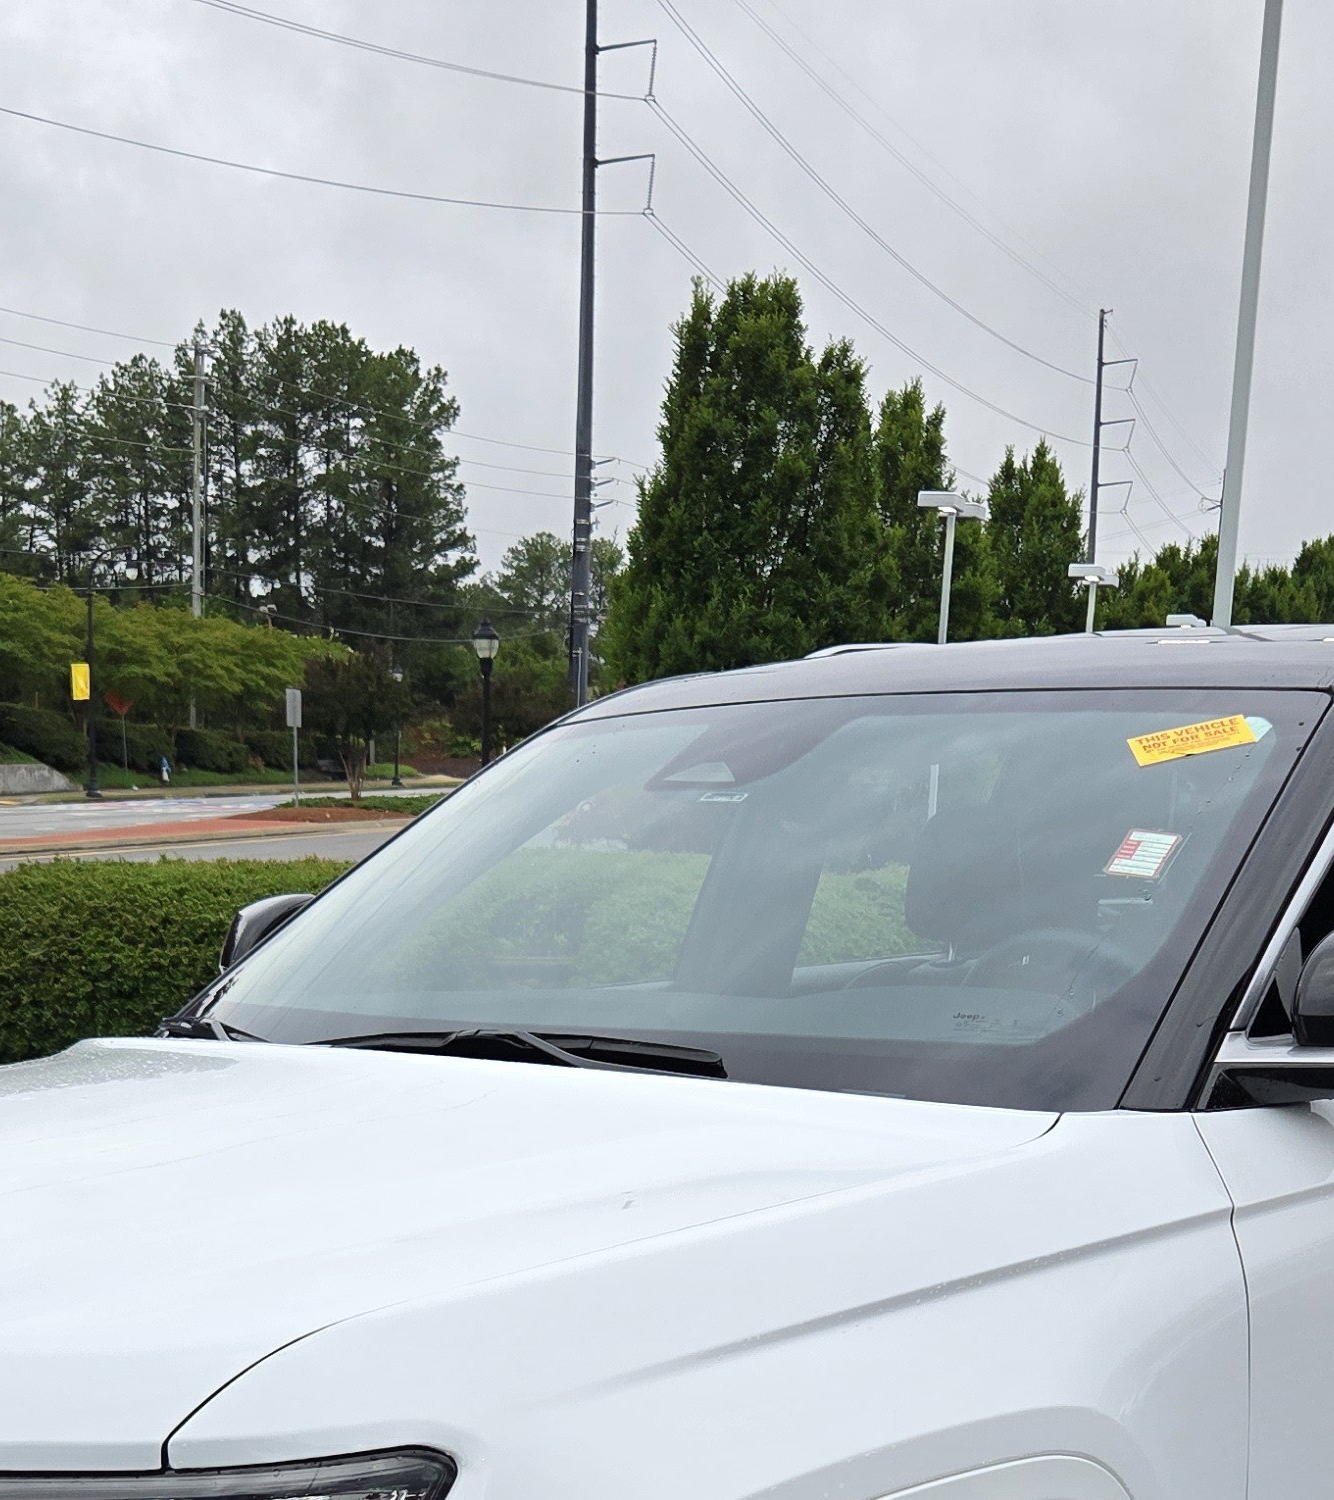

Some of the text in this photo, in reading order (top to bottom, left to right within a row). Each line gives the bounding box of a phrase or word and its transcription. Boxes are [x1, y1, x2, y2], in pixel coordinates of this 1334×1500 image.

[1136, 717, 1239, 746] THIS VEHICLE
[1142, 741, 1168, 752] NOT
[1172, 734, 1199, 745] FOR
[1204, 726, 1240, 738] SALE
[953, 1012, 980, 1022] Jeep
